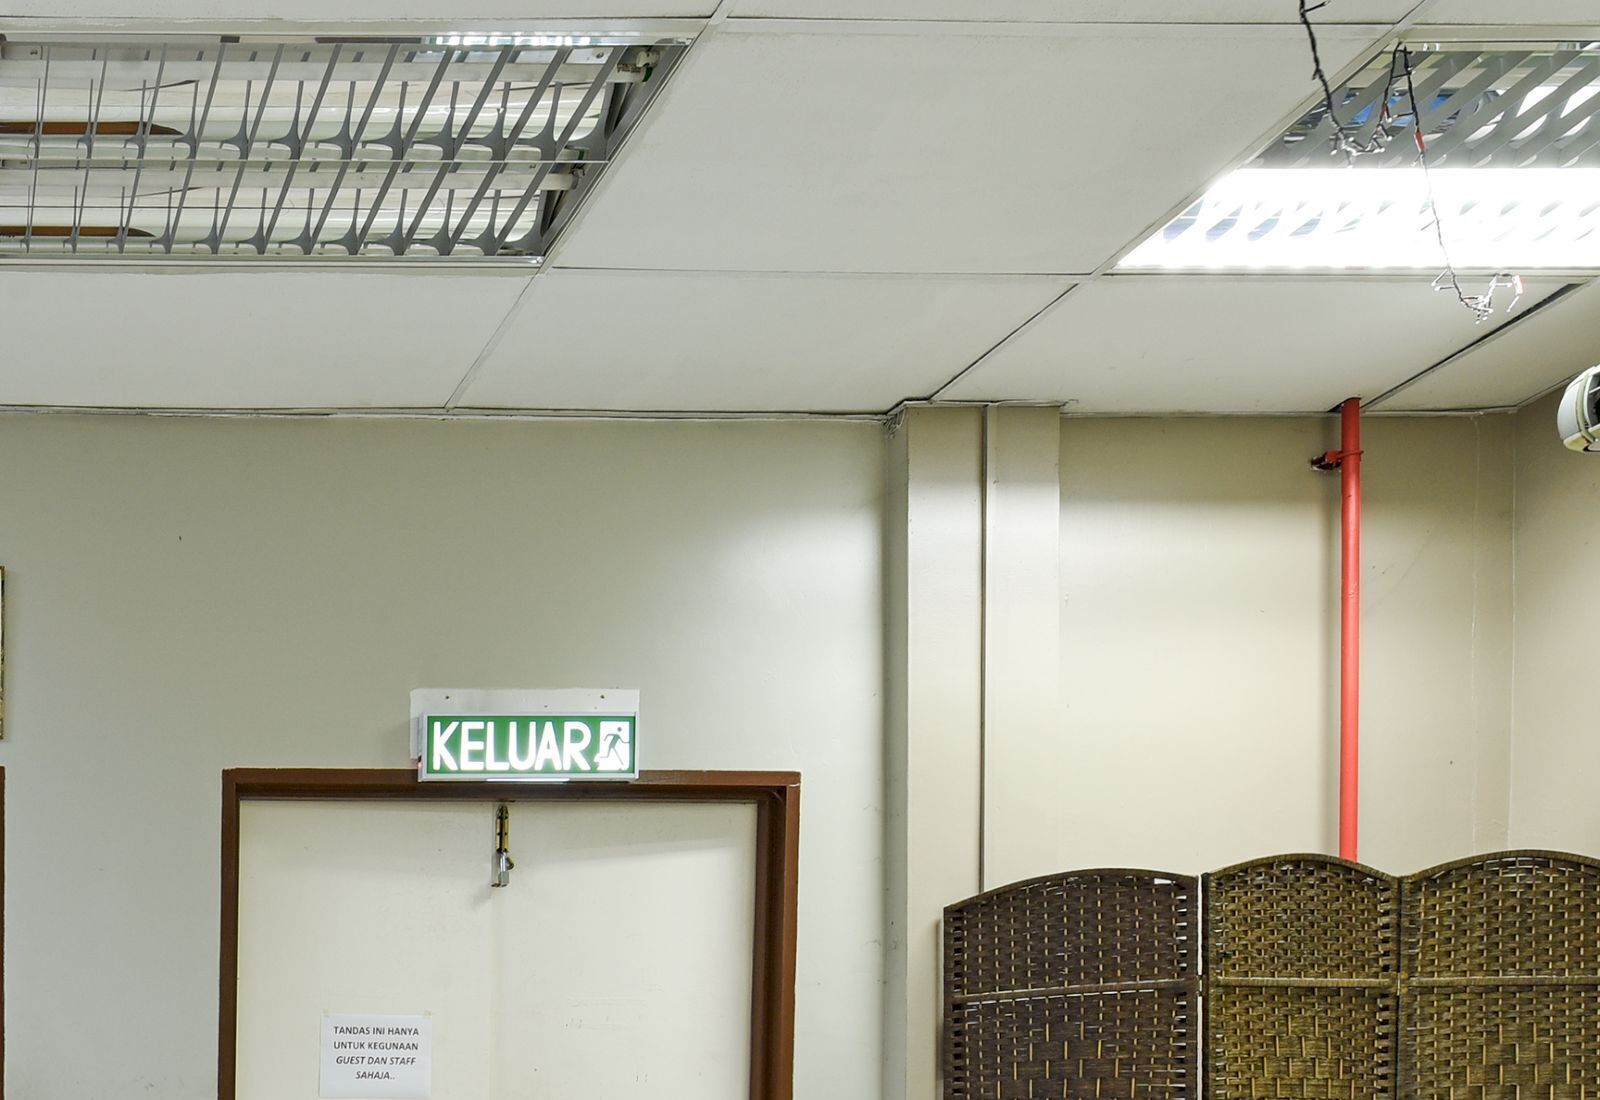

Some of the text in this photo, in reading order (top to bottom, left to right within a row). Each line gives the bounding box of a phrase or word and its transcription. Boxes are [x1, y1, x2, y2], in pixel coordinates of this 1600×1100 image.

[433, 721, 591, 770] KELUAR
[334, 1026, 419, 1036] TANDAS INI HANYA
[334, 1041, 418, 1051] UNTUK KEGUNAAN
[336, 1056, 416, 1065] GUEST DAN STAFF
